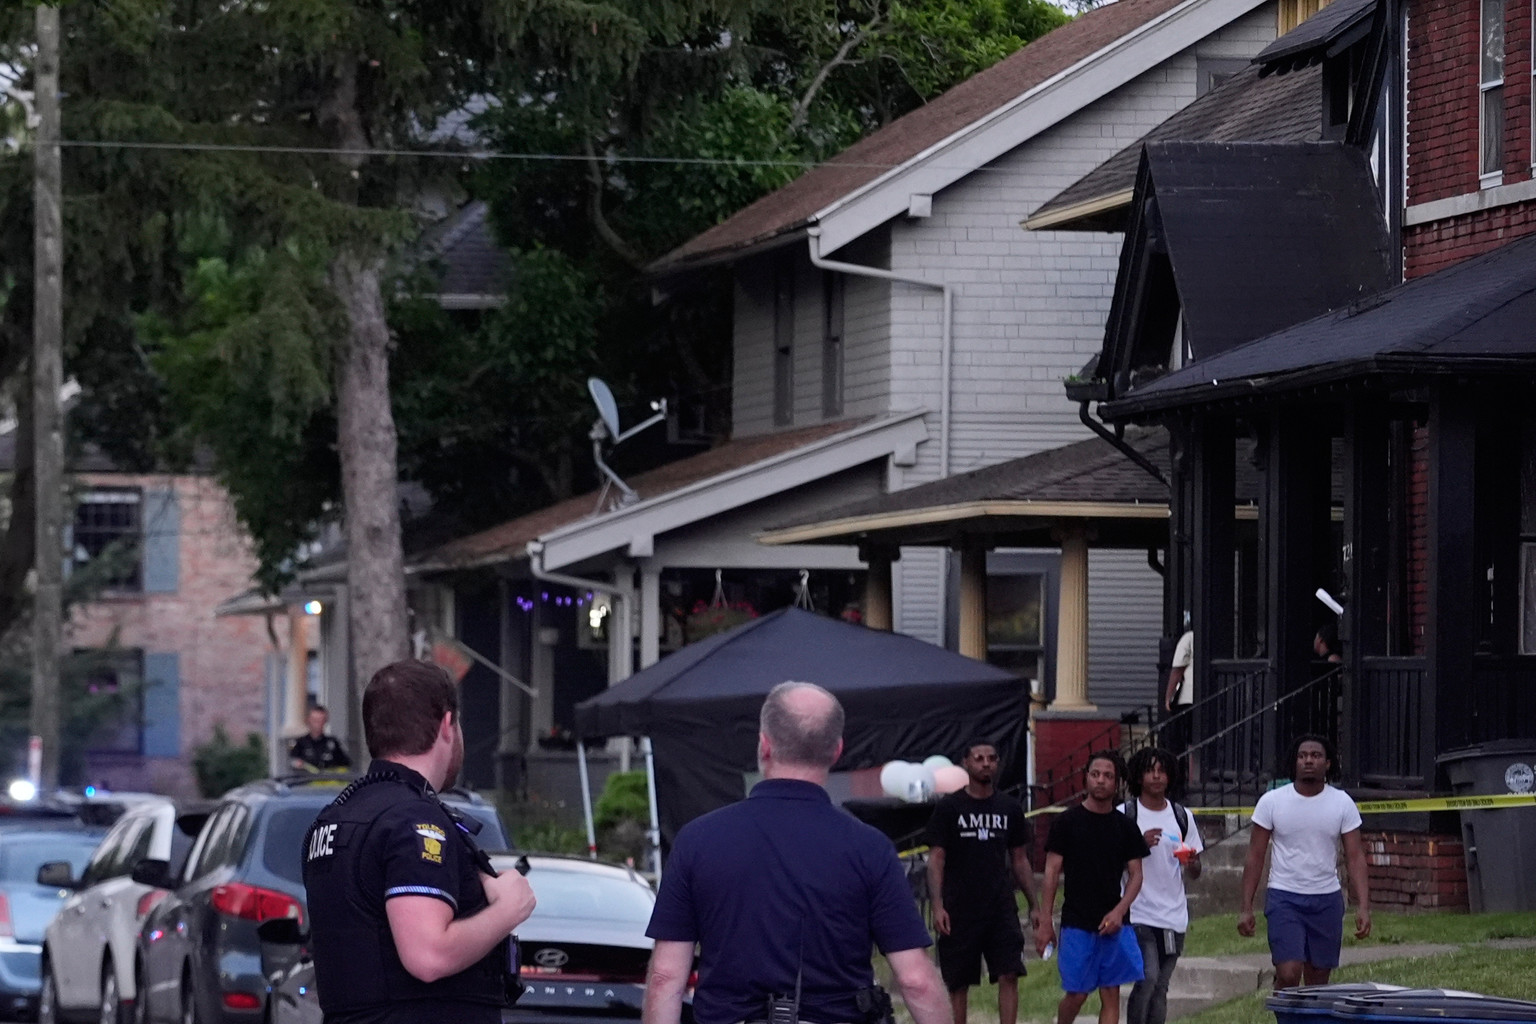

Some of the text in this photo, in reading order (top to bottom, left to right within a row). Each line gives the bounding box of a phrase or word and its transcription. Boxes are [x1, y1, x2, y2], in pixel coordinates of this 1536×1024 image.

[958, 812, 1008, 830] AMIRI
[307, 823, 338, 862] OLICE
[525, 985, 615, 997] ANTRA
